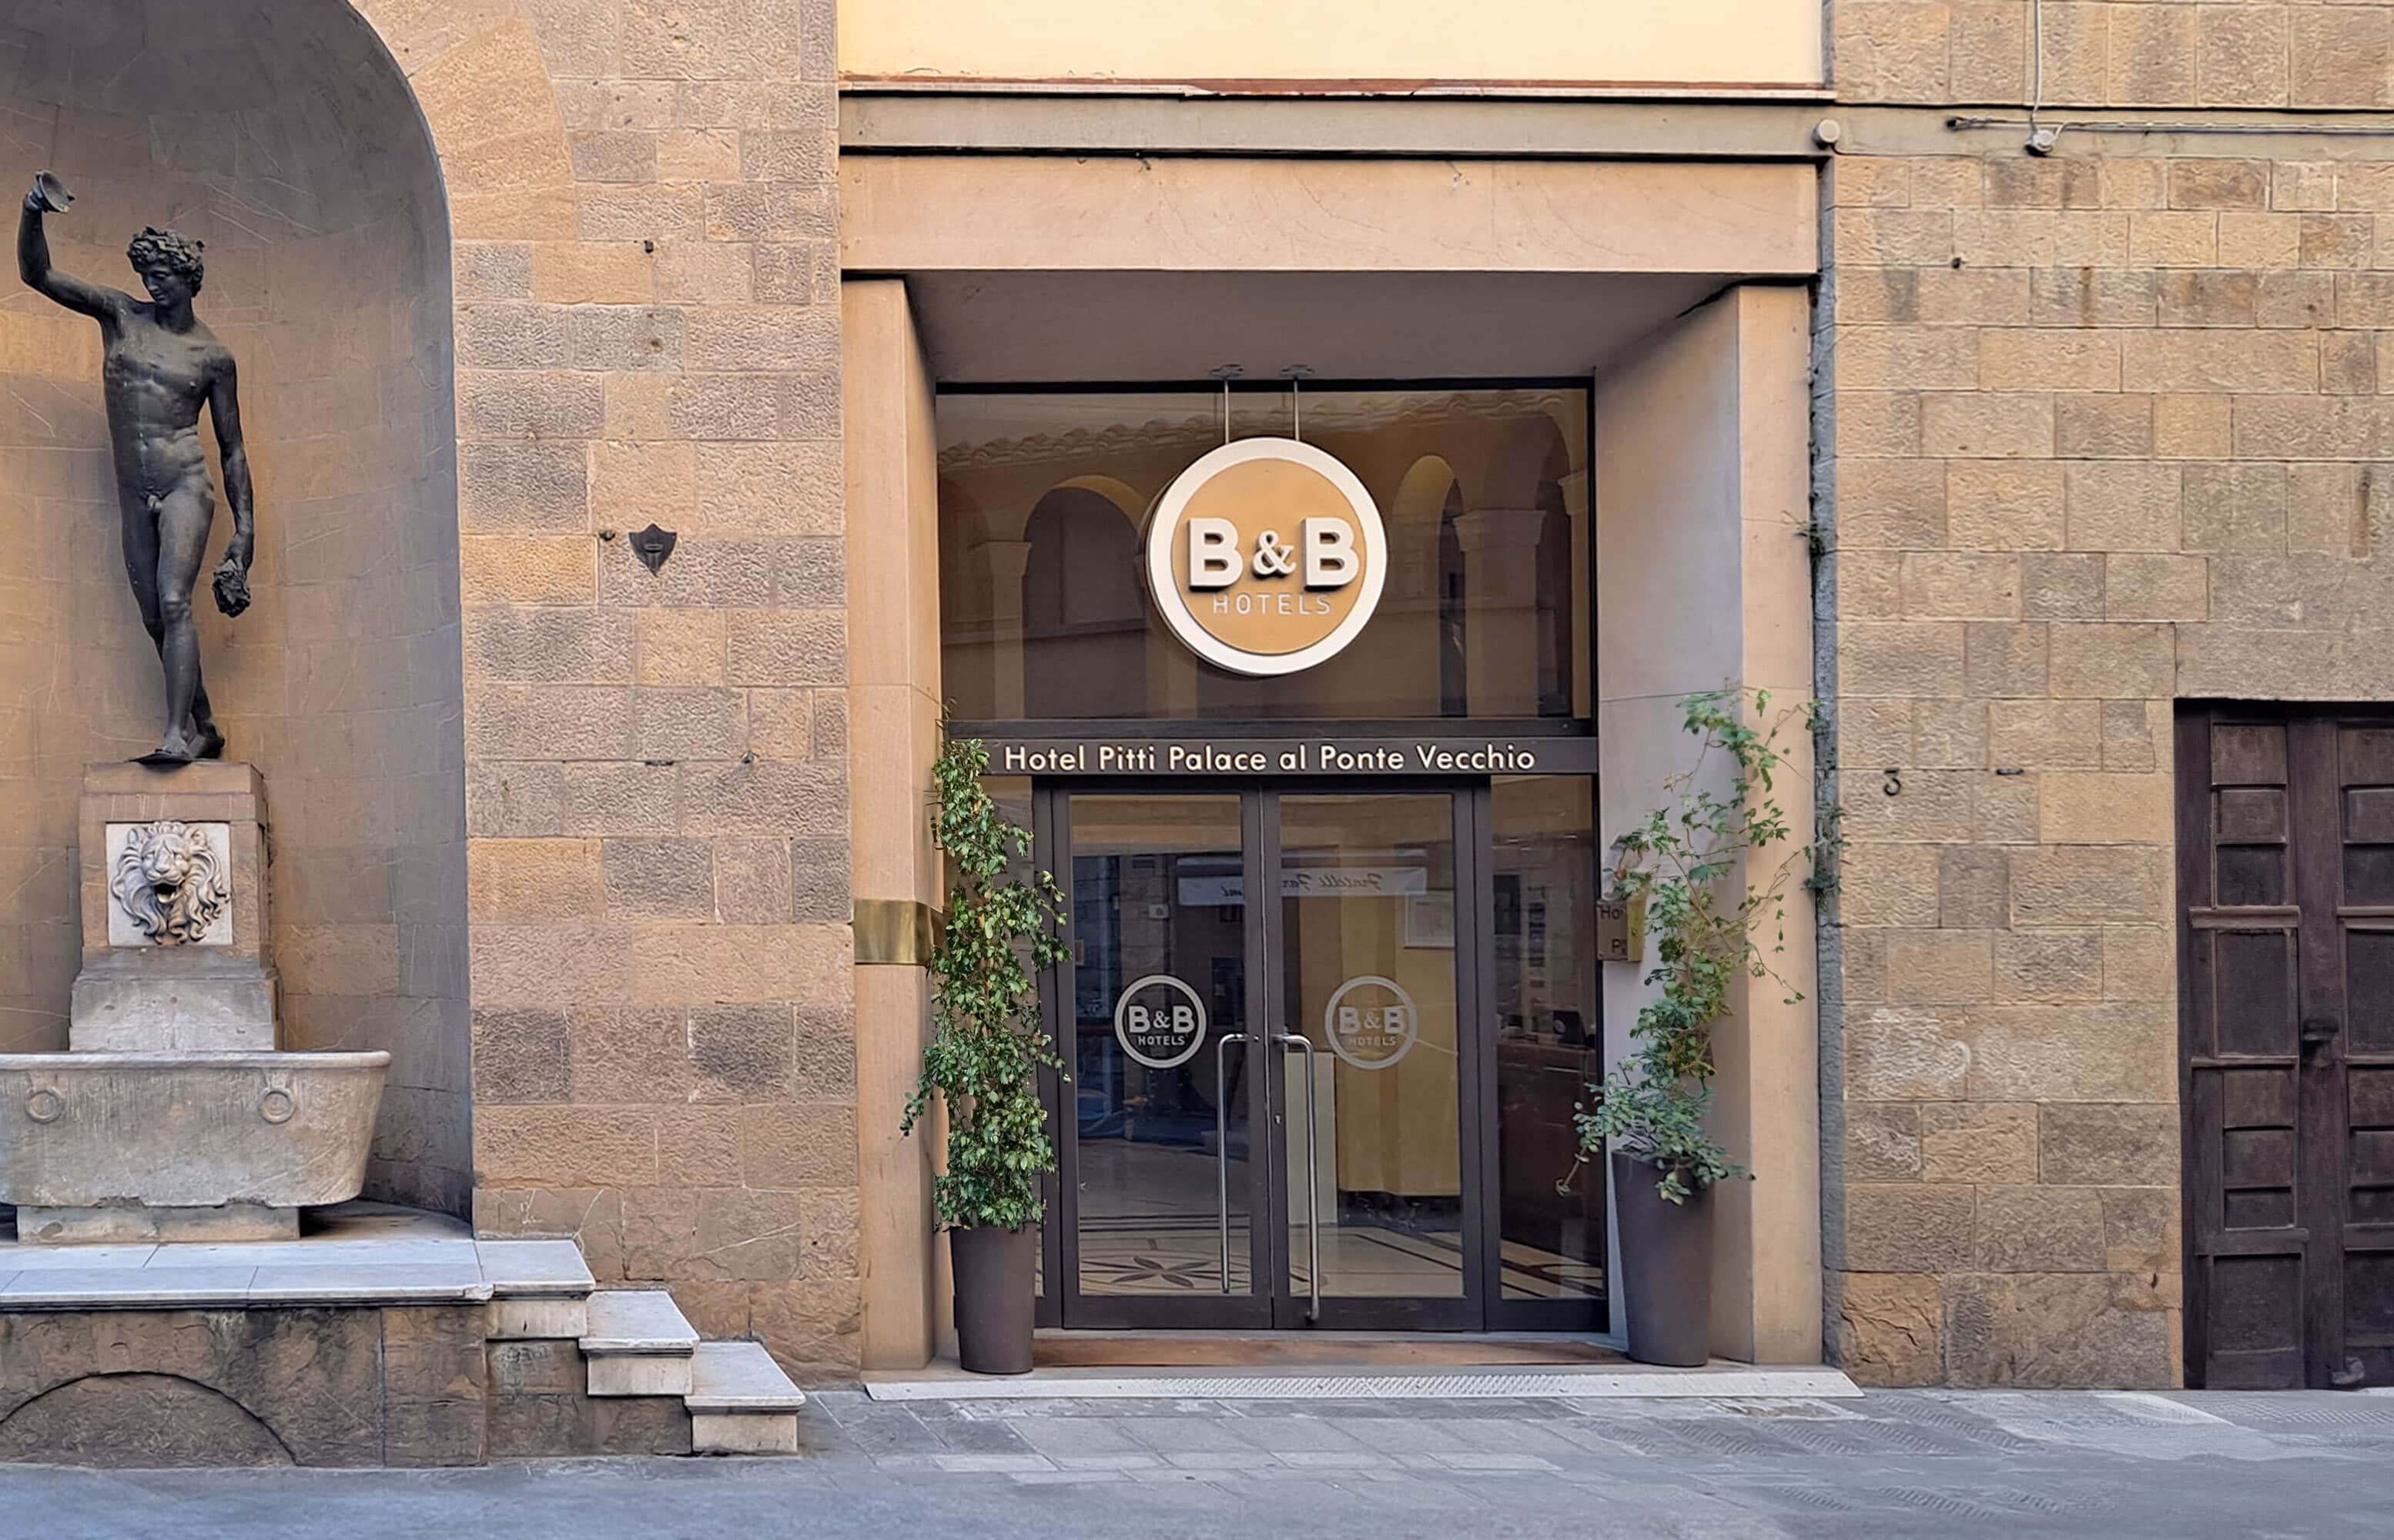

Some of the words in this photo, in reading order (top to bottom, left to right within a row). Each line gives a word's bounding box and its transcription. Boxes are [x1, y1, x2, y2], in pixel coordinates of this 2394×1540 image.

[1188, 517, 1360, 588] B&B
[1213, 593, 1331, 615] HOTELS
[1005, 745, 1084, 771] Hotel
[1099, 745, 1155, 771] Pitti
[1169, 745, 1267, 771] Palace
[1279, 744, 1306, 770] al
[1320, 745, 1405, 770] Ponte
[1416, 743, 1535, 770] Vecchio
[1883, 769, 1901, 796] 3
[1128, 1005, 1195, 1033] B&B
[1338, 1006, 1405, 1034] B&B
[1138, 1035, 1185, 1046] HOTELS
